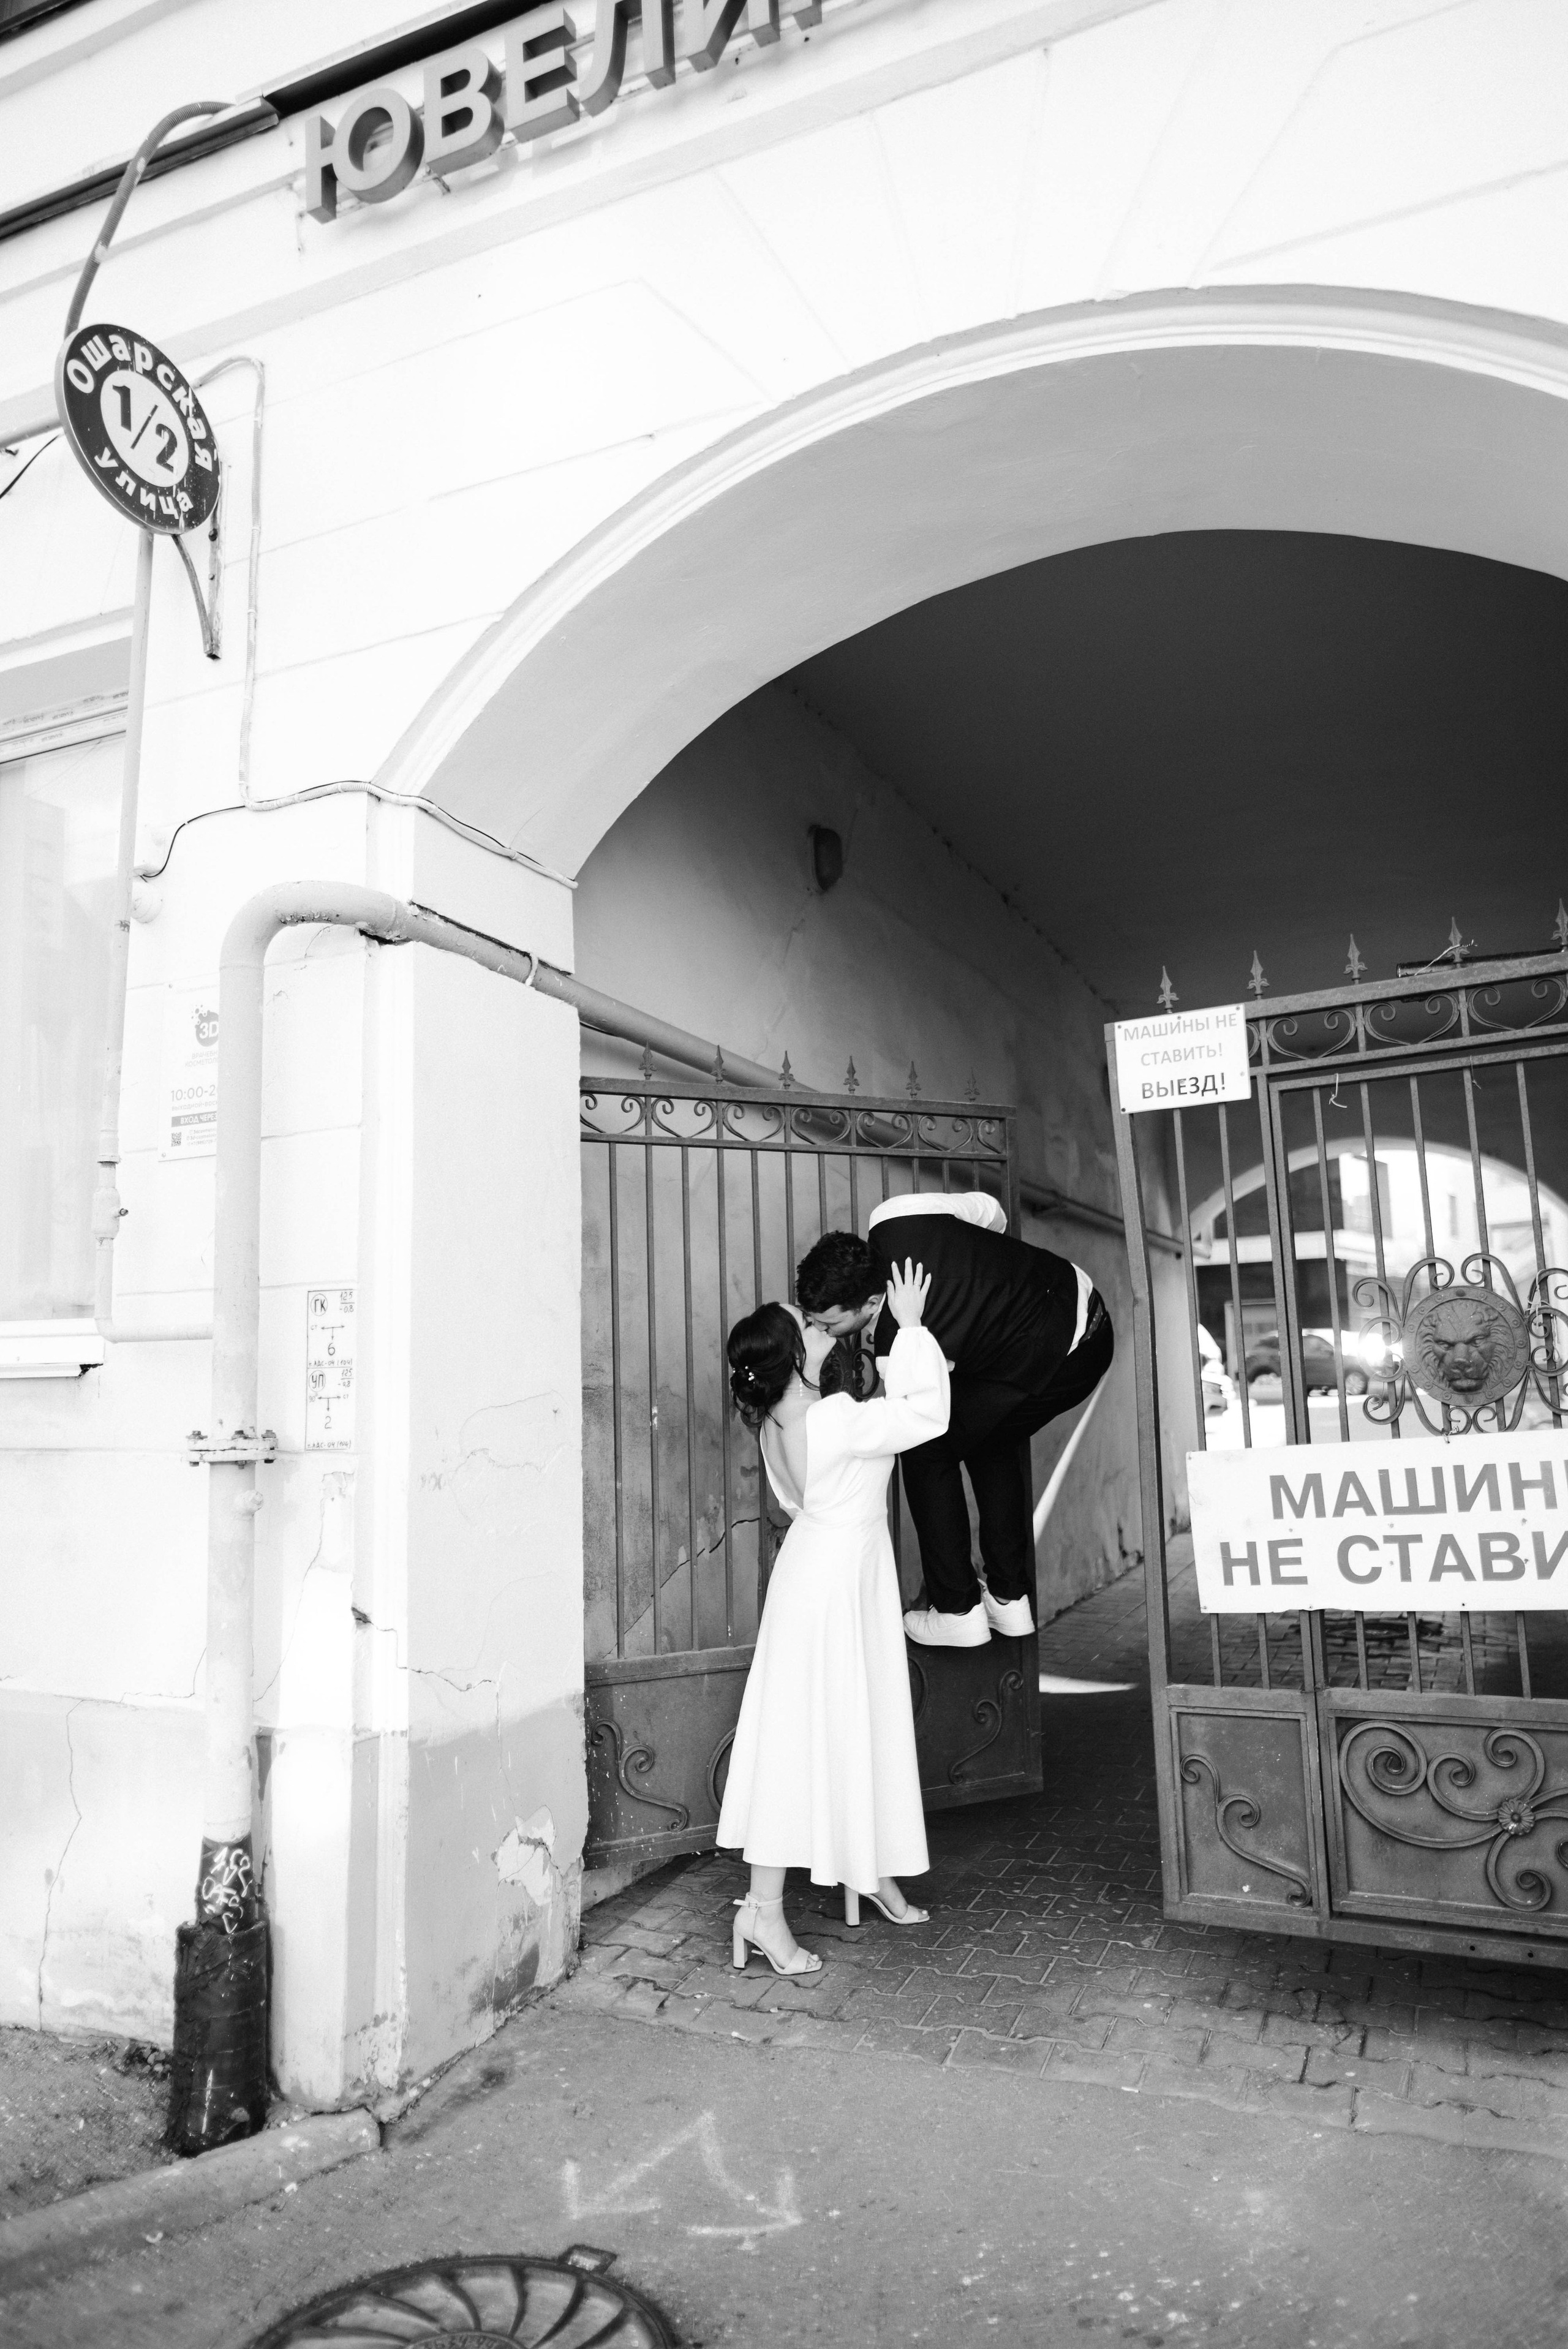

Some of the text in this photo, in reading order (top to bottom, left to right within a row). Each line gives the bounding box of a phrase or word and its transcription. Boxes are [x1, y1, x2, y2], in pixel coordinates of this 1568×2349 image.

[305, 0, 823, 224] ЮВЕЛ
[111, 384, 178, 474] 1/2
[199, 1021, 219, 1039] 3D
[1123, 1013, 1237, 1041] МАШИНЫ НЕ
[1140, 1043, 1223, 1066] СТАВИТЬ!
[170, 1084, 218, 1102] 10:00-2
[1141, 1072, 1226, 1099] ВЫЕЗД!
[180, 1115, 200, 1125] ВХОД
[339, 1291, 353, 1301] 125
[314, 1299, 326, 1313] ГК
[328, 1342, 336, 1356] 6
[311, 1374, 324, 1389] УП
[341, 1368, 353, 1377] 125
[324, 1416, 332, 1429] 2
[1269, 1460, 1568, 1520] МАШИН
[1219, 1531, 1568, 1586] НЕ СТАВИ
